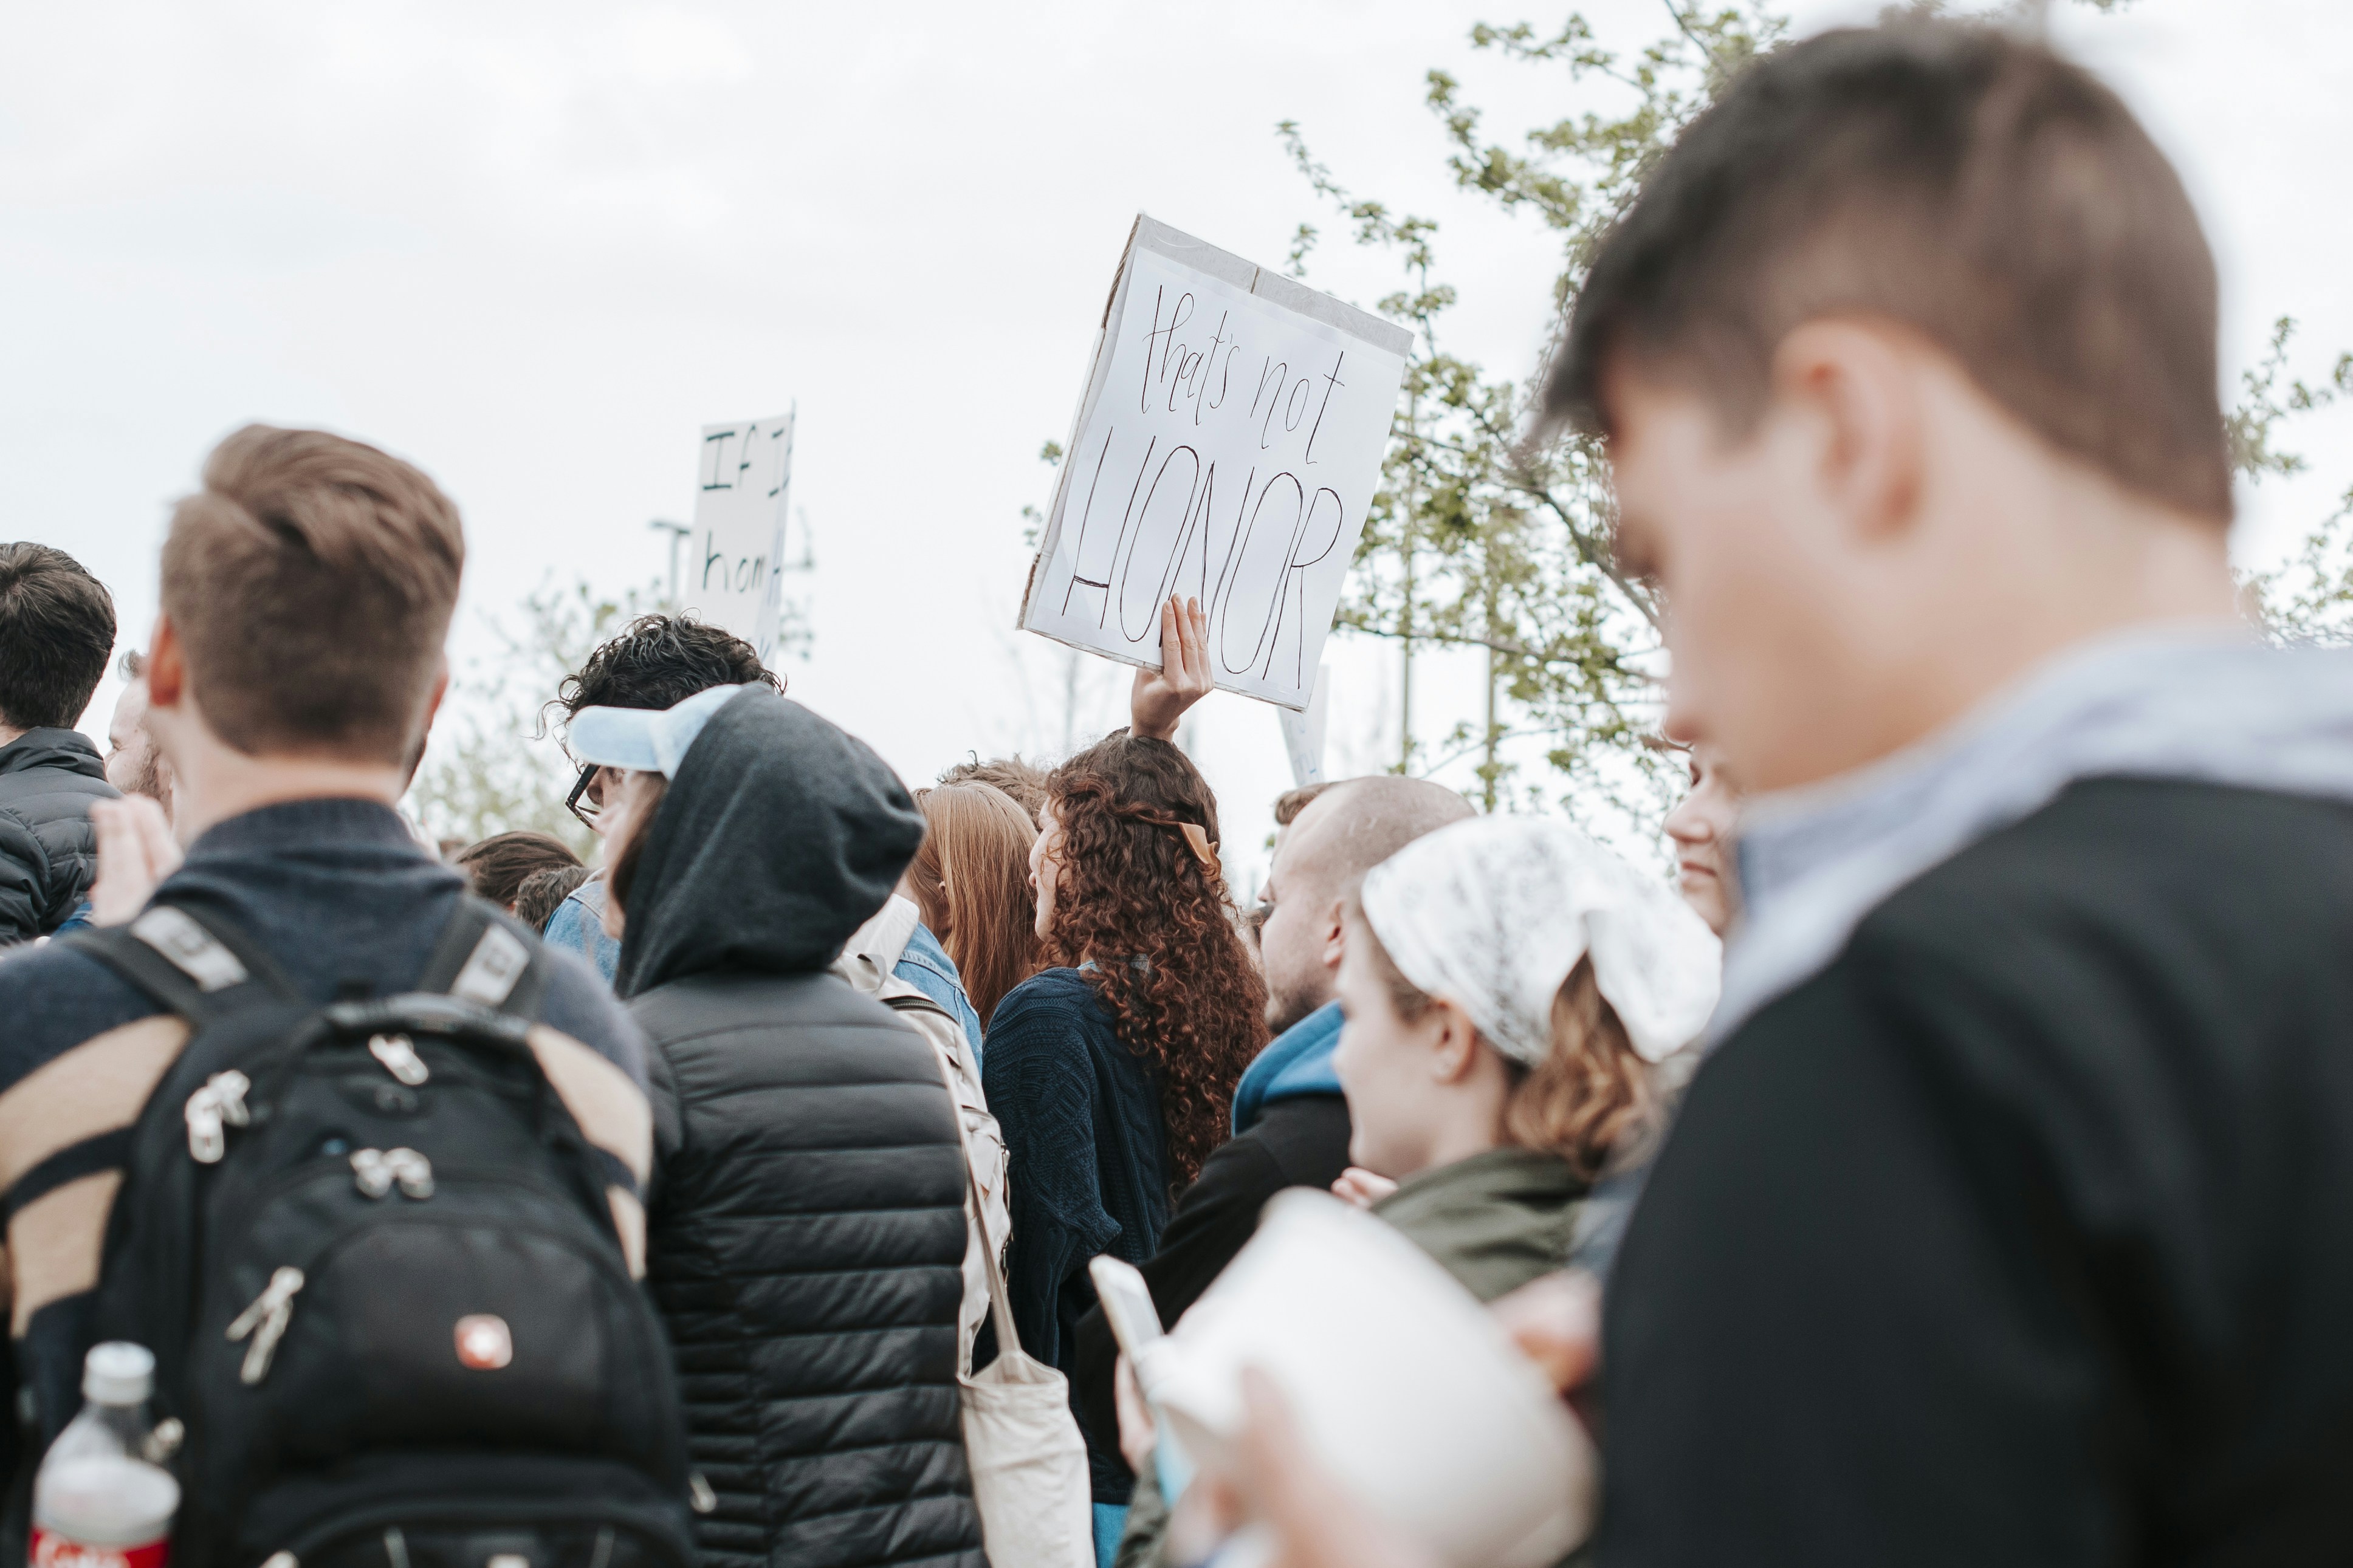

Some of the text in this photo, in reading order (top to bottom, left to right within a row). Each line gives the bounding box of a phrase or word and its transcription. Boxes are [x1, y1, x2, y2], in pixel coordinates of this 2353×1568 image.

[1141, 285, 1345, 464] that's not
[1062, 426, 1343, 690] HONOR
